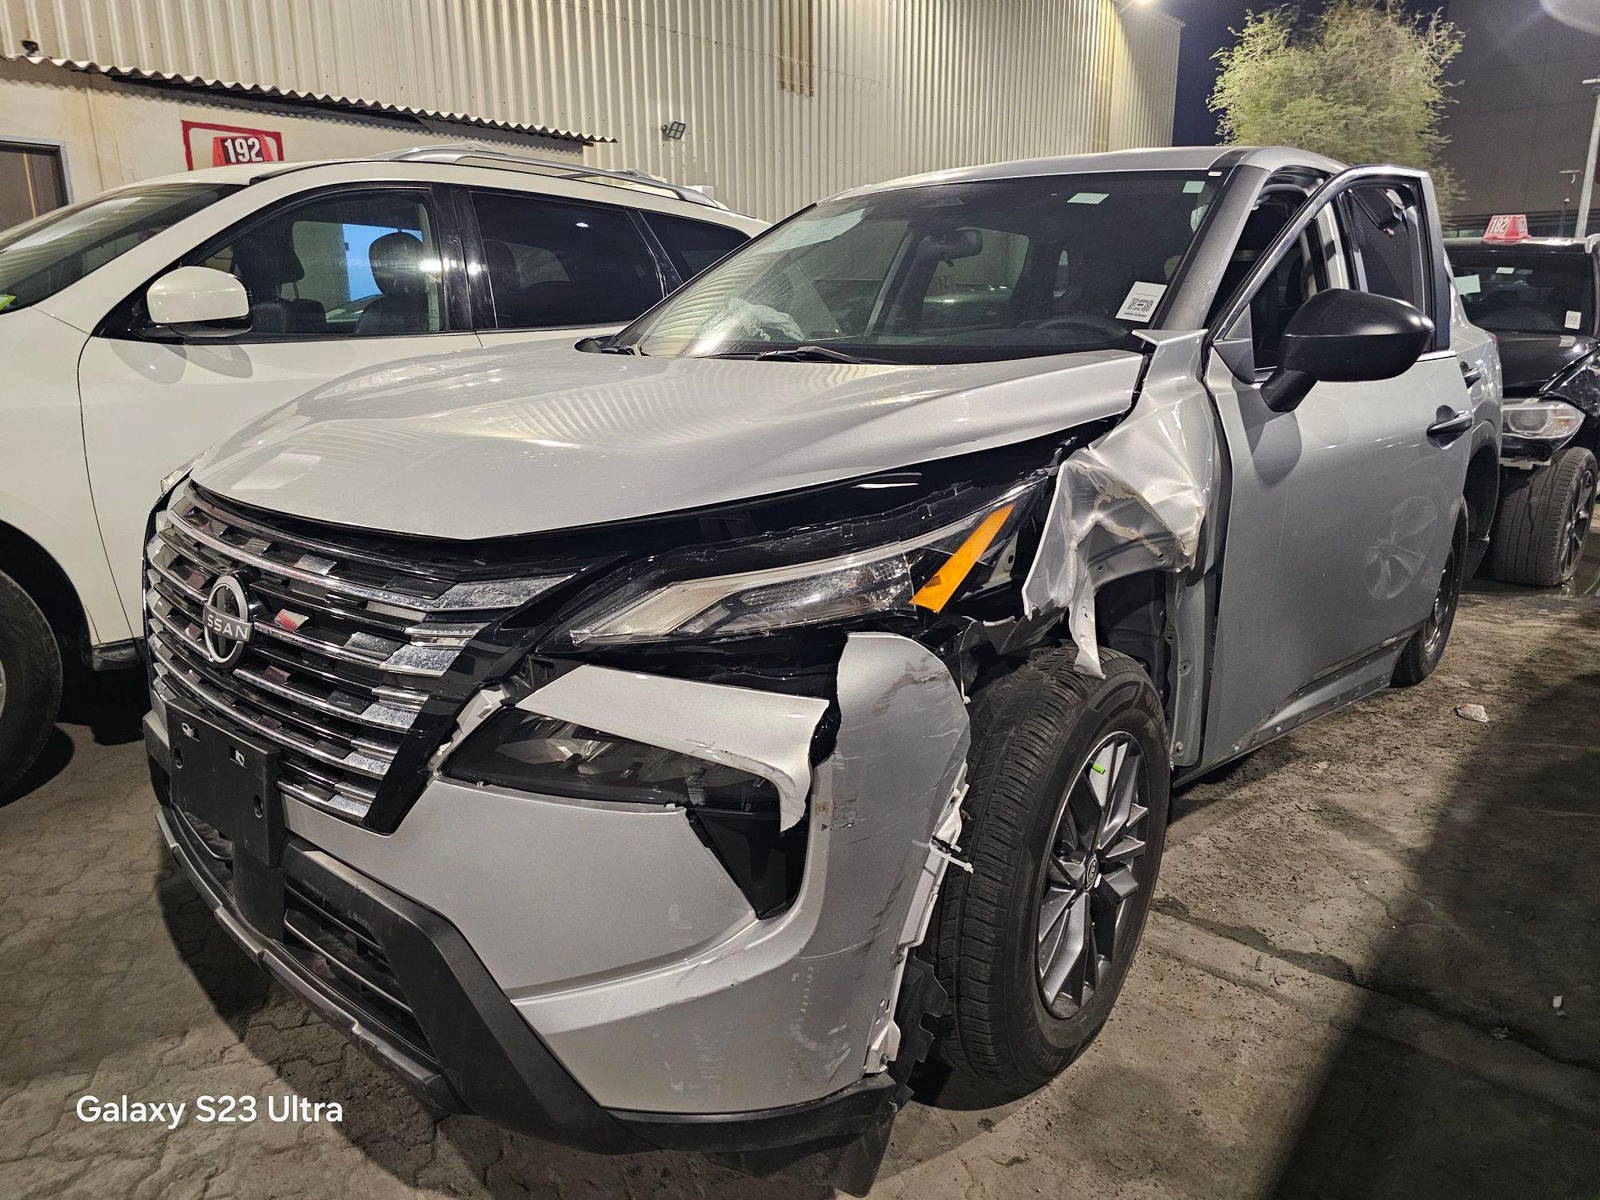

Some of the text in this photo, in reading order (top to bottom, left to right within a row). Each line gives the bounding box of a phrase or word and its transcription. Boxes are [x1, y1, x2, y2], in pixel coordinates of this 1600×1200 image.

[224, 137, 264, 163] 192
[1489, 216, 1509, 233] 182
[207, 613, 248, 640] SSAN
